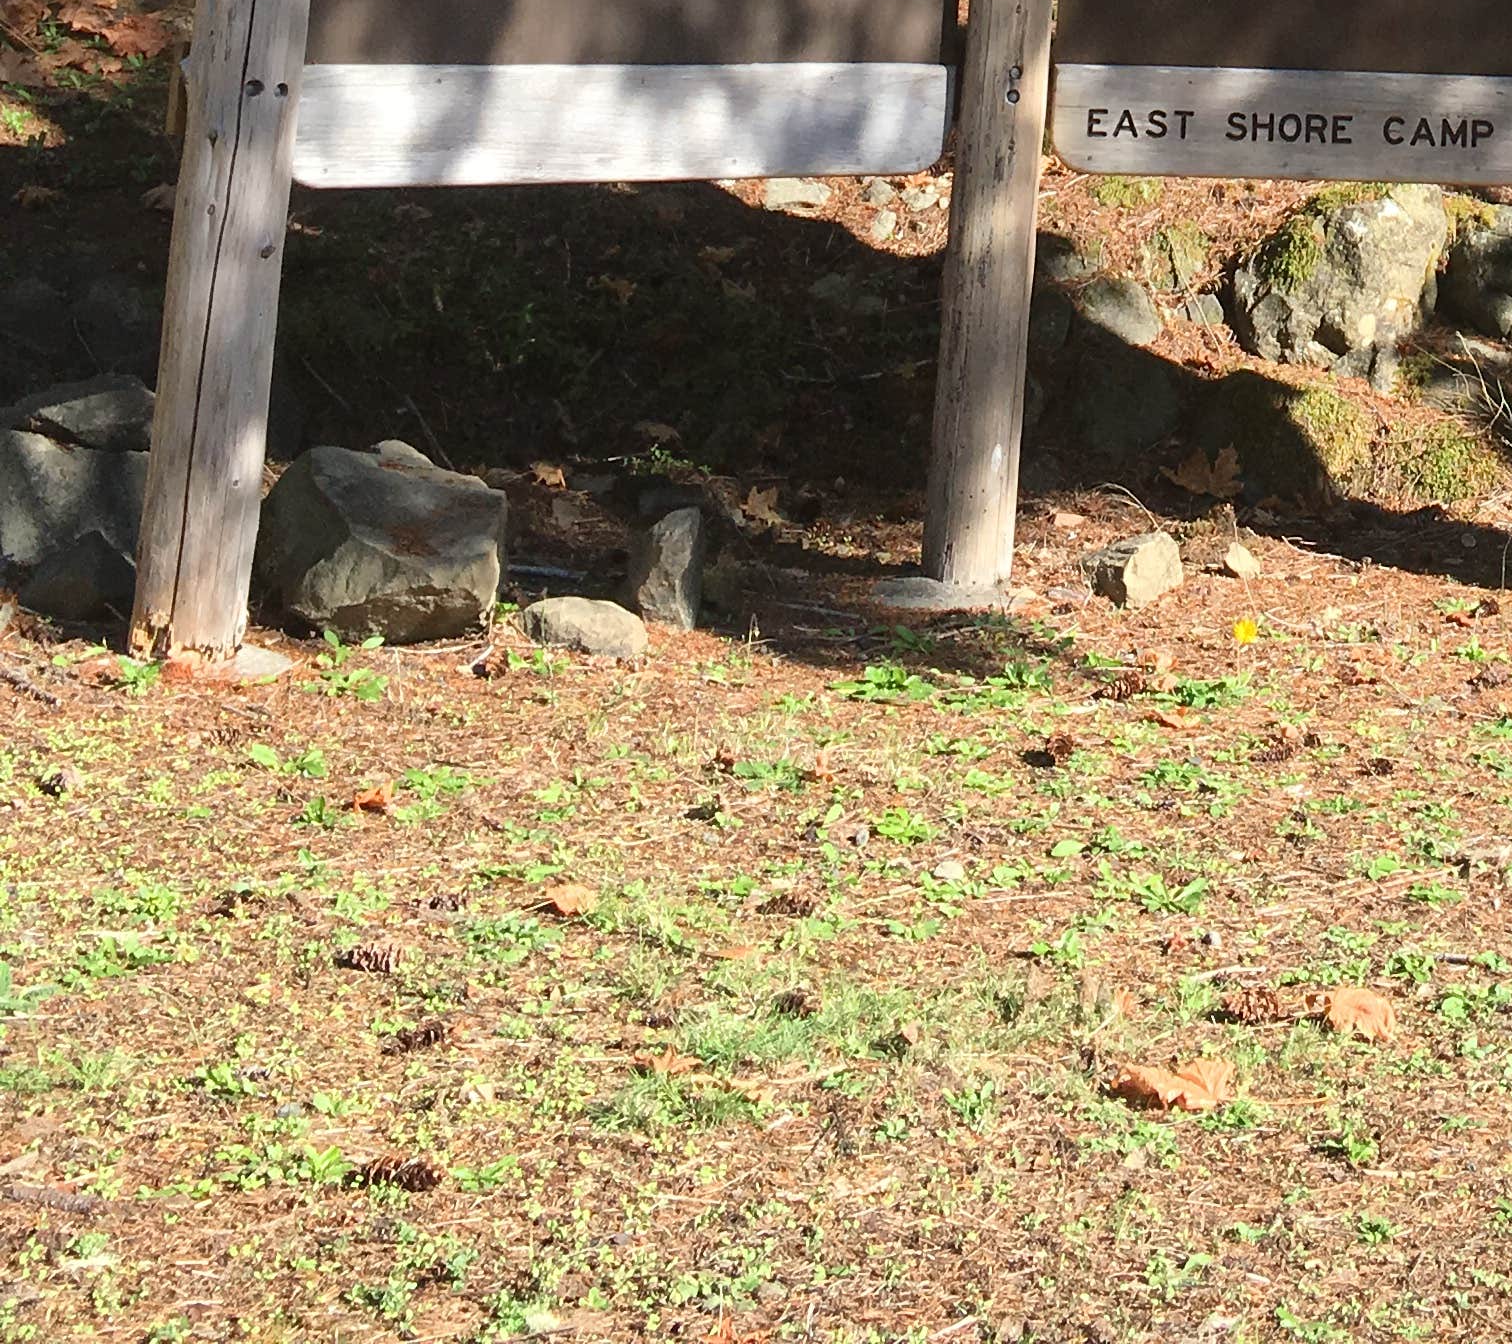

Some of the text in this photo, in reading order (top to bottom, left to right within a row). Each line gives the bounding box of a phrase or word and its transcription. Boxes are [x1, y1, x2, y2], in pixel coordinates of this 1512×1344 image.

[1087, 108, 1195, 140] EAST
[1225, 111, 1354, 146] SHORE
[1383, 115, 1494, 151] CAMP
